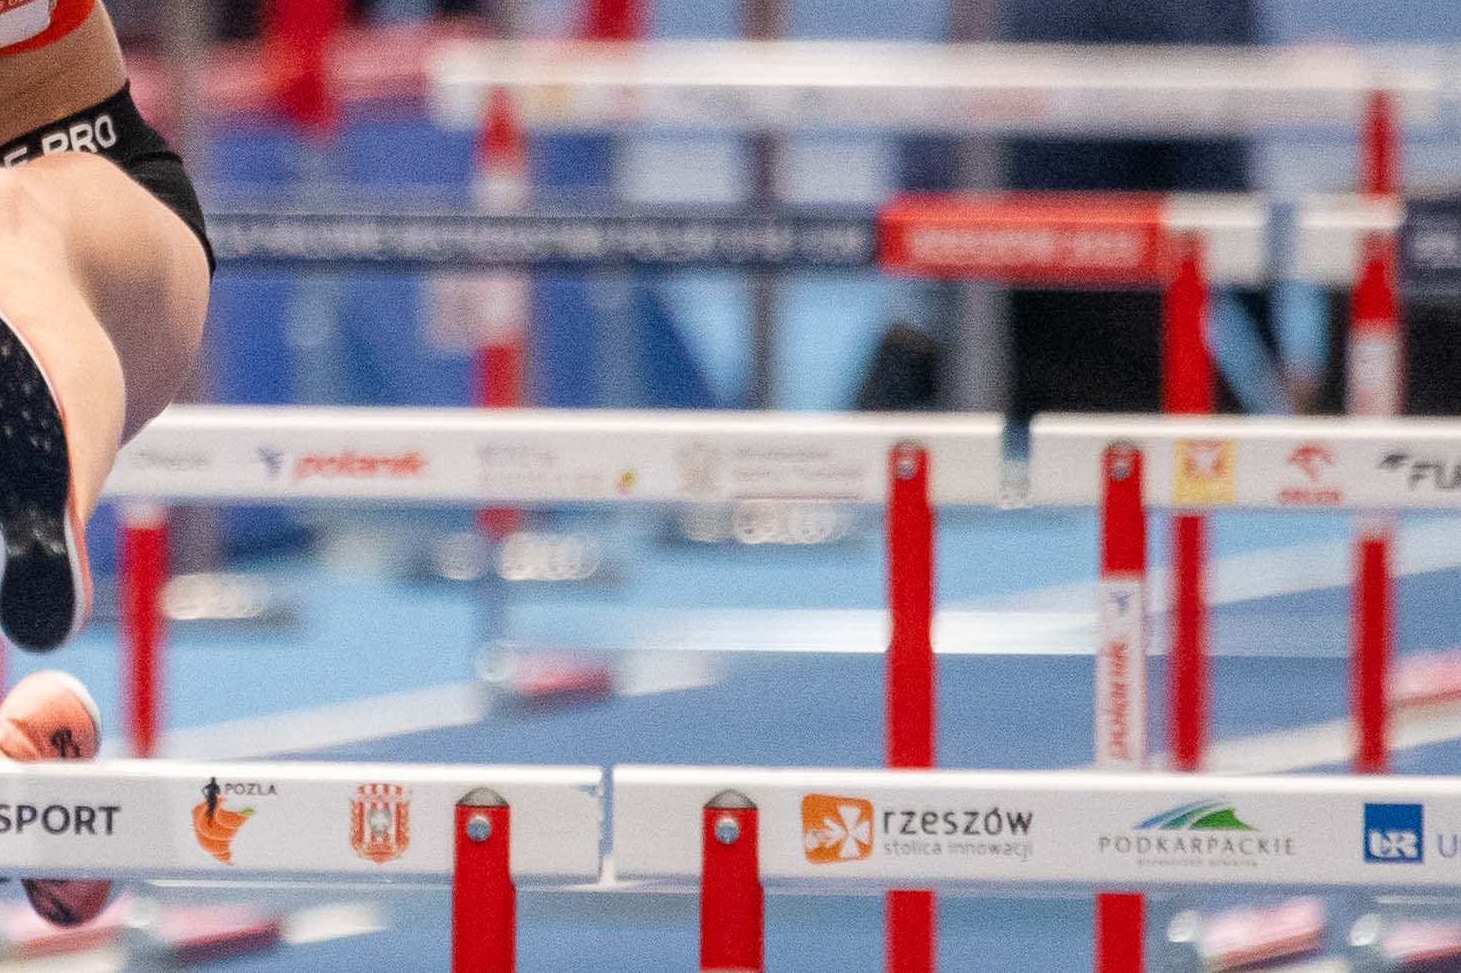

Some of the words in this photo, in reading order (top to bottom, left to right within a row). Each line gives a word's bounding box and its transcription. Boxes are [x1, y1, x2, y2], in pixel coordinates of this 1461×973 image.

[41, 114, 117, 156] PRO
[224, 782, 278, 796] POZLA
[882, 806, 1033, 836] rzeszów
[884, 839, 941, 856] stolica
[1098, 834, 1296, 855] PODKARPACKIE
